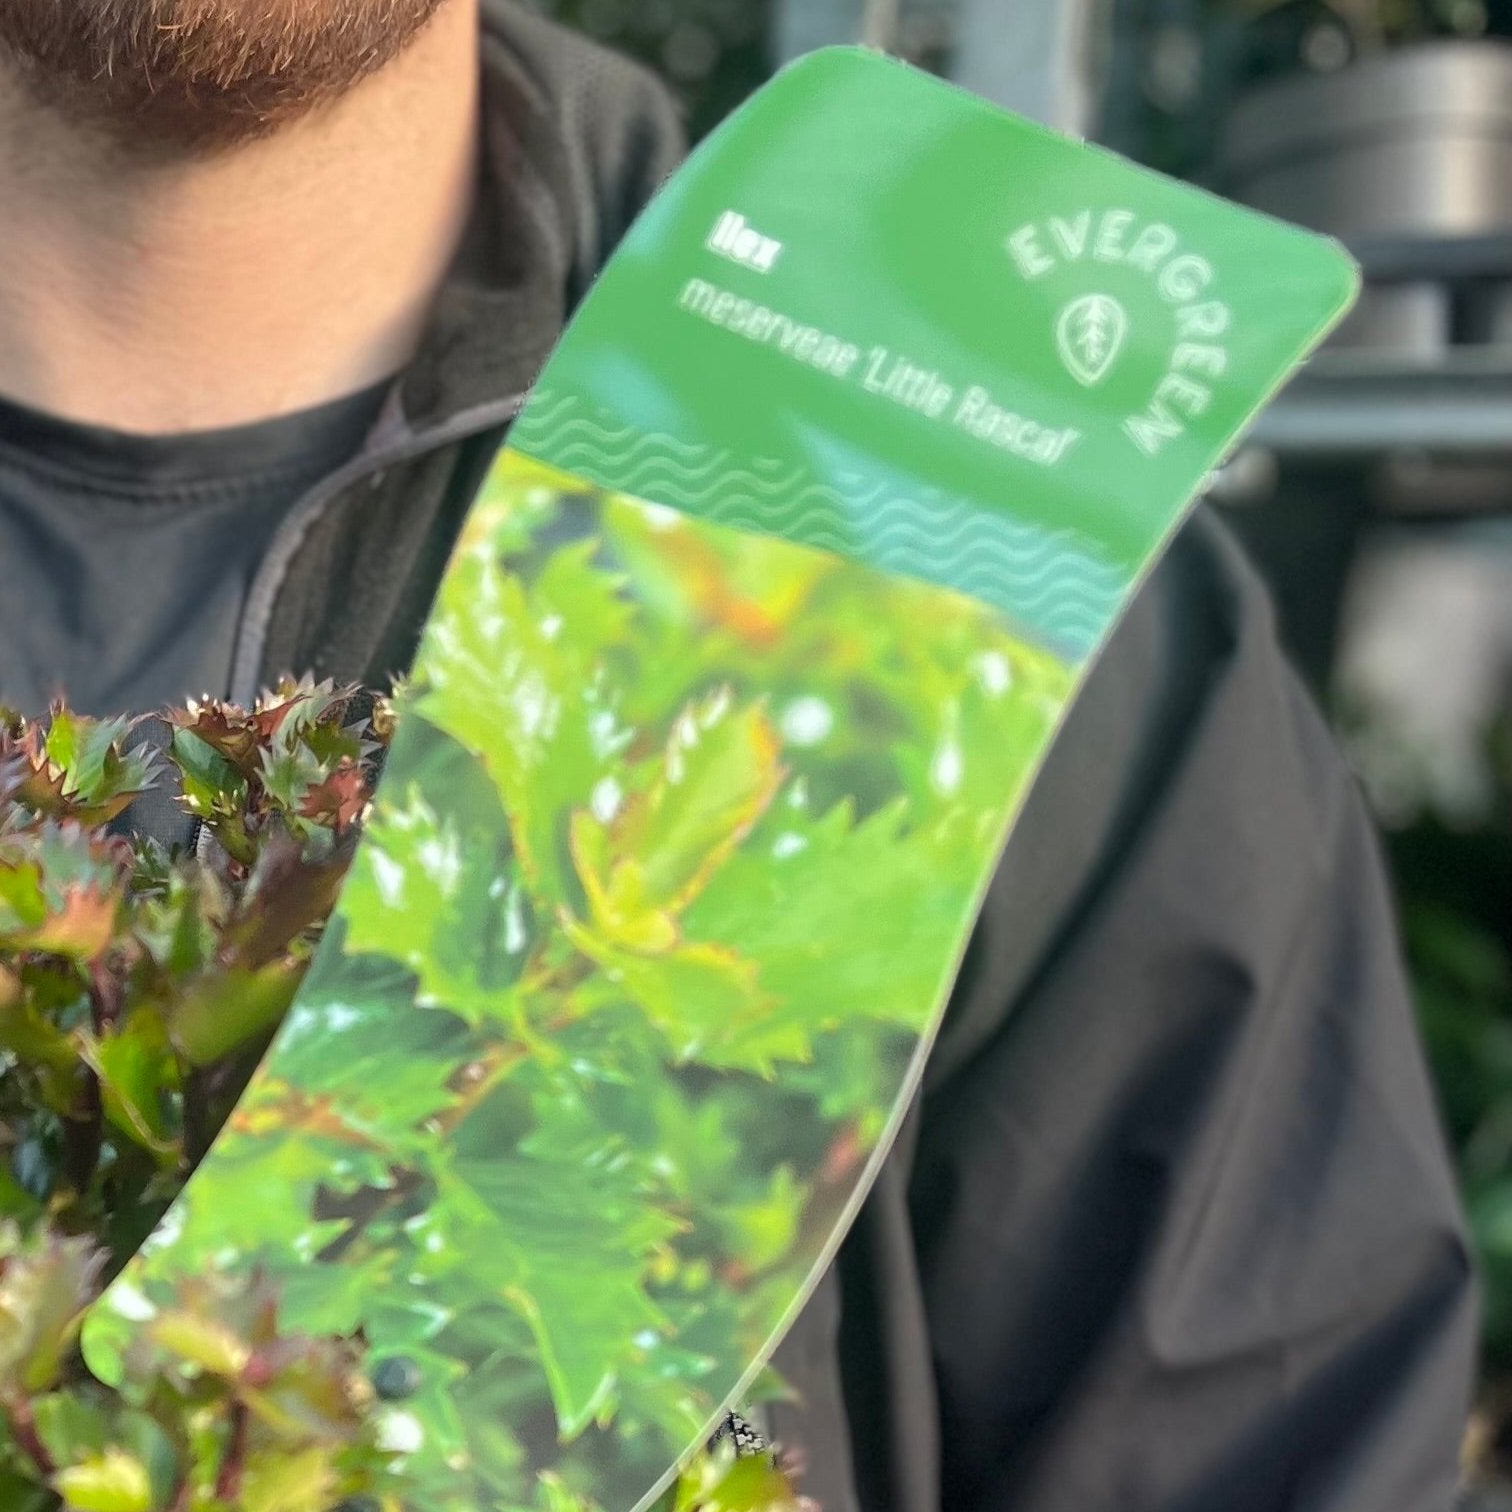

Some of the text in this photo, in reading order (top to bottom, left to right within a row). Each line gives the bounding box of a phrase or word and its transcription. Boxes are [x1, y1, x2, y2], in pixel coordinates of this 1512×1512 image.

[707, 210, 783, 273] Ilex
[679, 278, 860, 376] meserveae
[863, 346, 954, 418] 'Little
[1007, 210, 1230, 456] EVERGREEN
